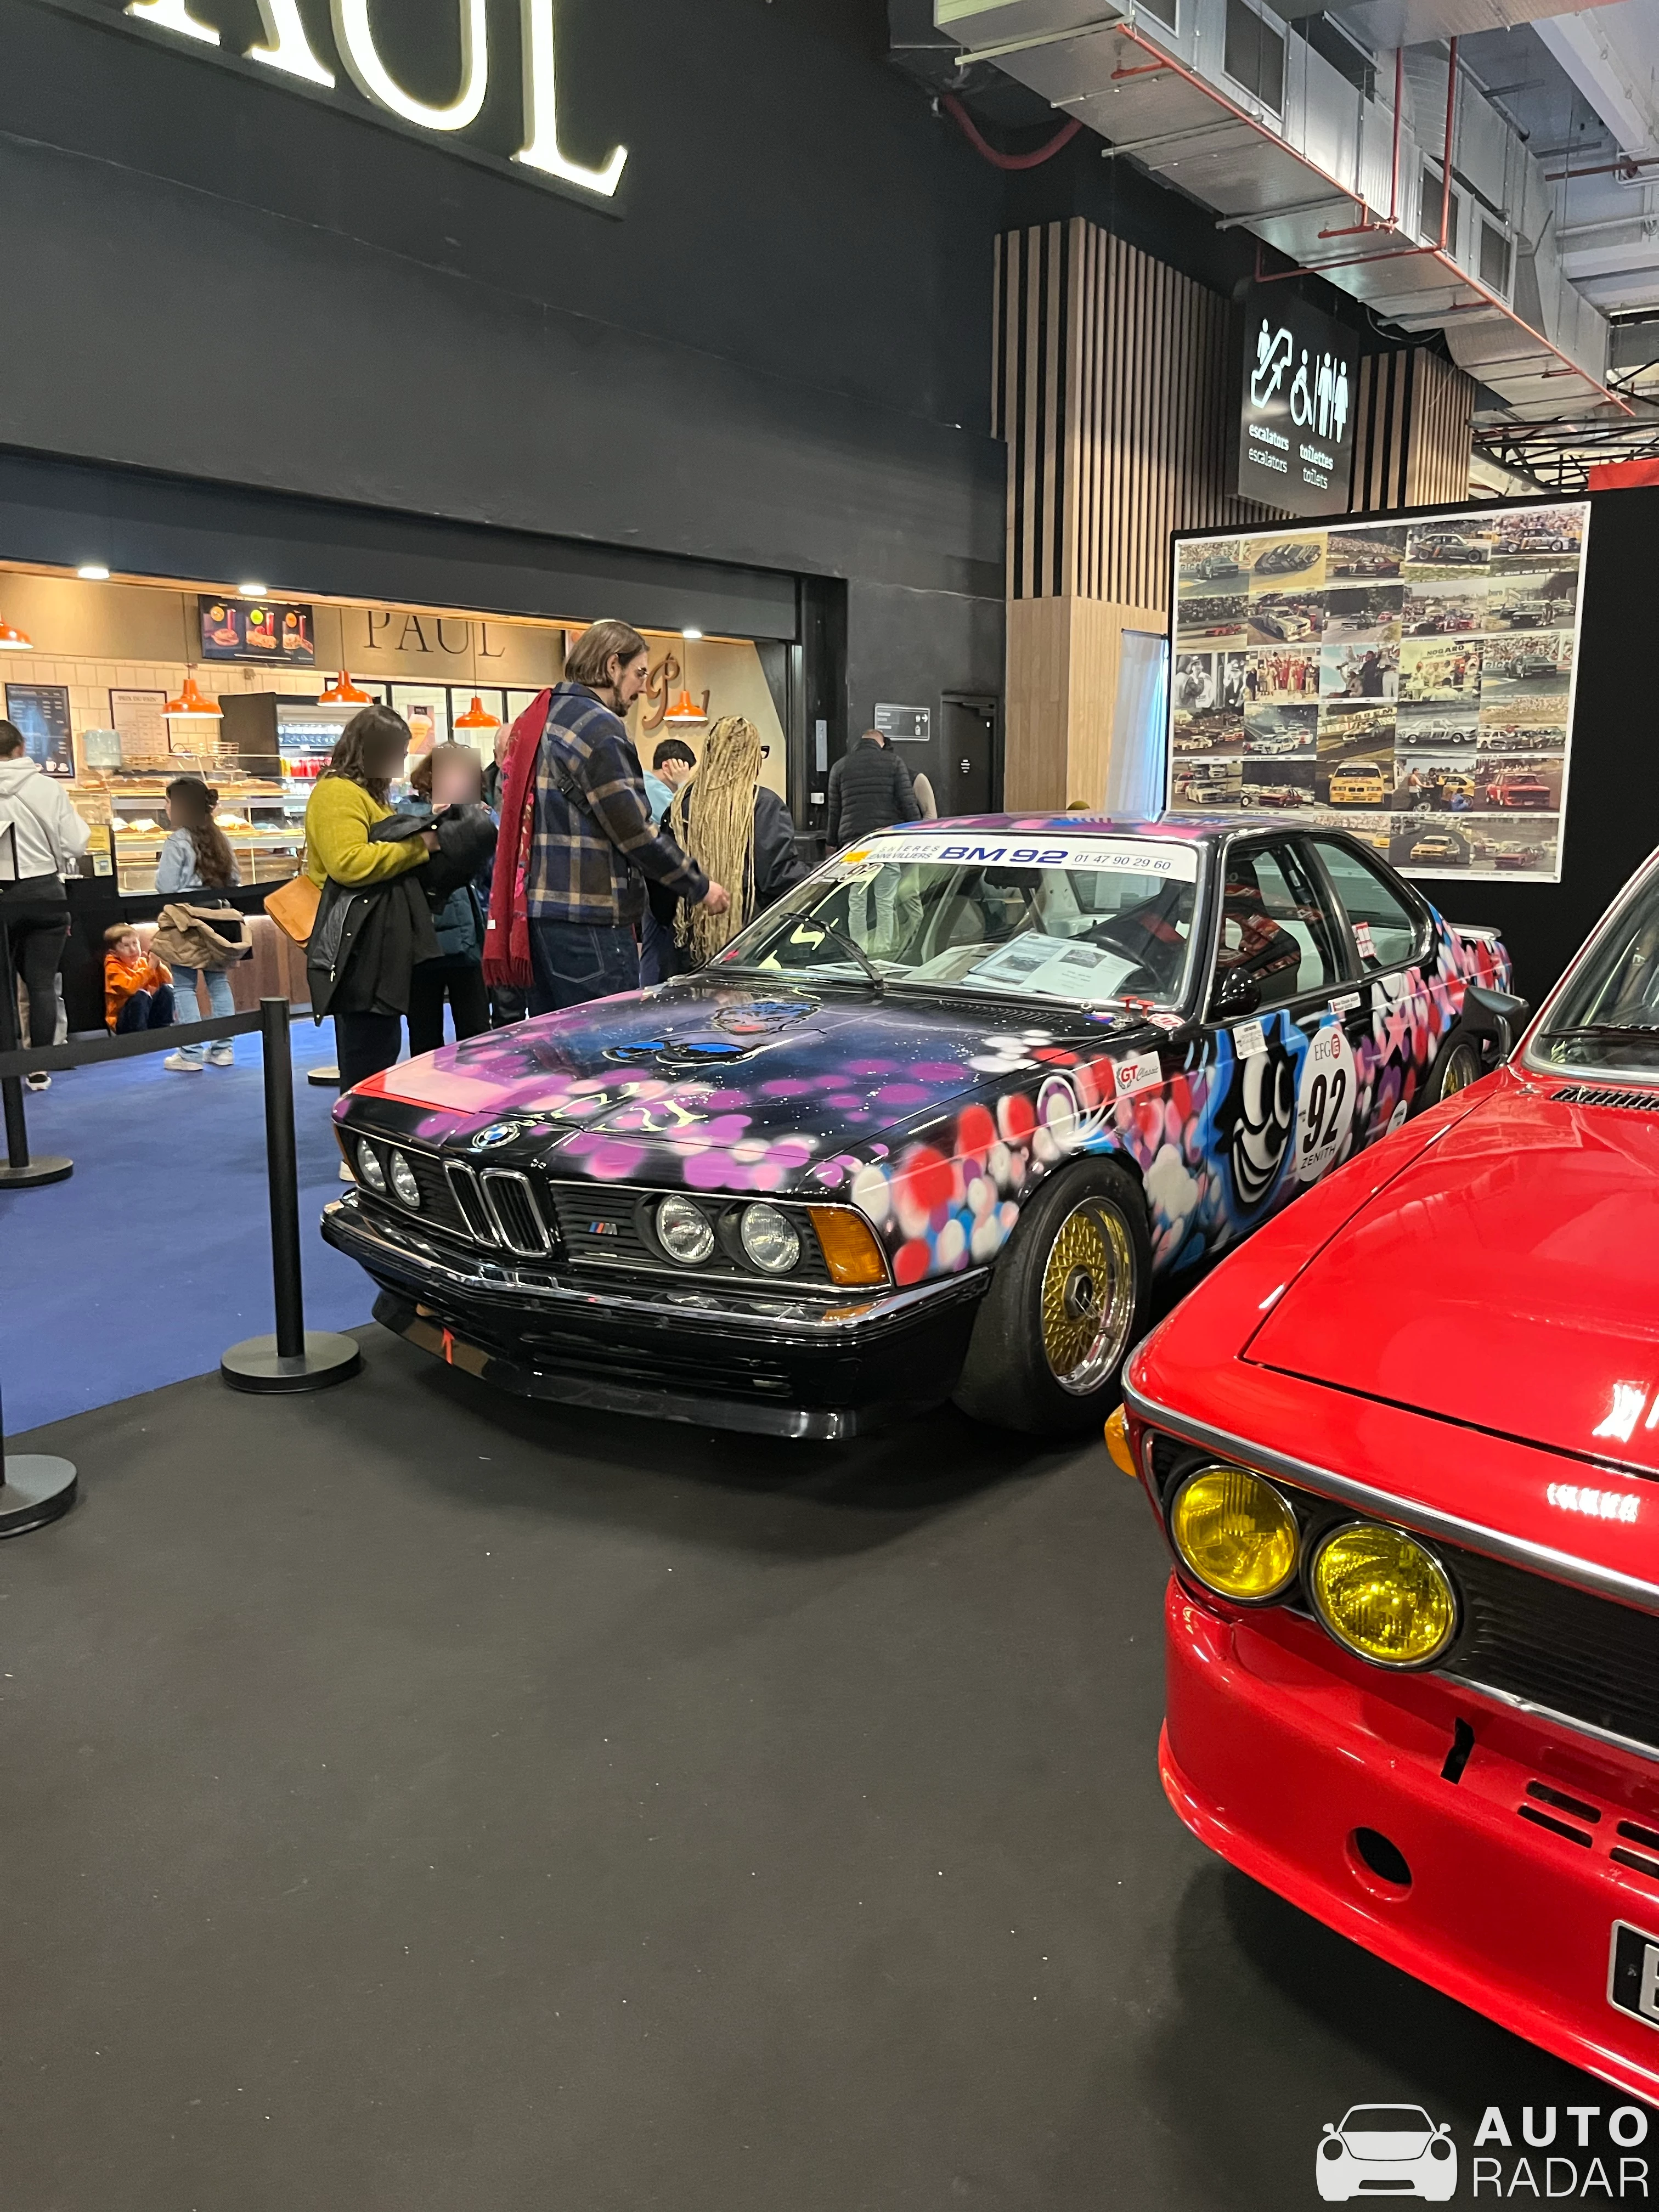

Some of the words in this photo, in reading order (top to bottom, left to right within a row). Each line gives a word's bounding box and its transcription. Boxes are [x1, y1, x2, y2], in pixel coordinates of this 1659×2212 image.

[1249, 424, 1289, 451] escalators
[1248, 448, 1288, 473] escalators
[1300, 444, 1334, 470] toilettes
[1303, 467, 1328, 489] toilets
[364, 611, 505, 657] PAUL
[1426, 645, 1464, 656] NOGARO
[937, 847, 1007, 861] BM
[1009, 849, 1069, 864] 92
[1074, 854, 1089, 862] 01
[1093, 855, 1110, 864] 47
[1113, 856, 1130, 865] 90
[1133, 857, 1150, 867] 29
[1154, 860, 1171, 870] 60
[1314, 1041, 1331, 1061] EFG
[1121, 1065, 1138, 1082] GT
[1303, 1069, 1346, 1154] 92
[1301, 1144, 1336, 1169] ZENITH
